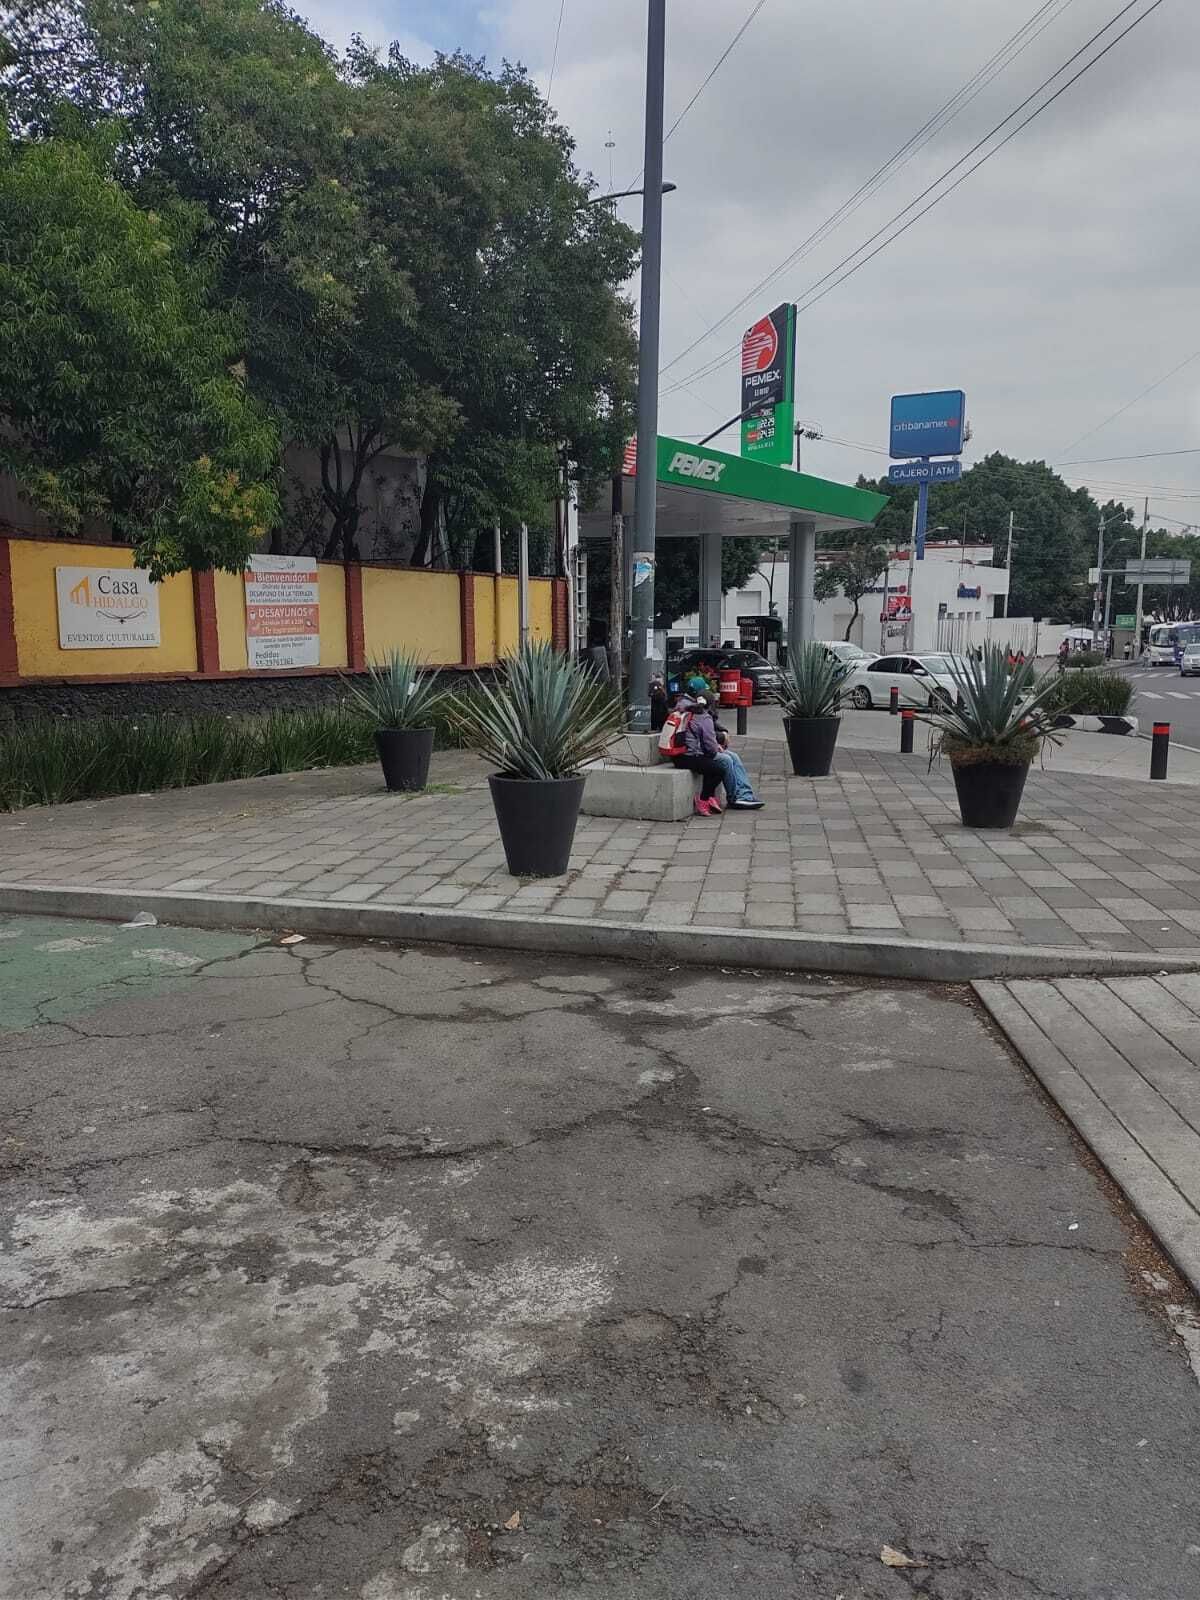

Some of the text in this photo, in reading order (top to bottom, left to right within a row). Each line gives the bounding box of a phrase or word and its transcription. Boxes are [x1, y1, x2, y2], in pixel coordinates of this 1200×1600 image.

[745, 369, 781, 388] PEMEX
[894, 419, 947, 431] citibanamex
[668, 452, 726, 482] PEMEX
[893, 466, 954, 478] CAJERO ATM
[97, 575, 139, 595] Casa
[93, 597, 148, 609] HIDALGO
[258, 607, 308, 618] DESAYUNOS
[67, 631, 155, 642] EVENTOS CULTURALES
